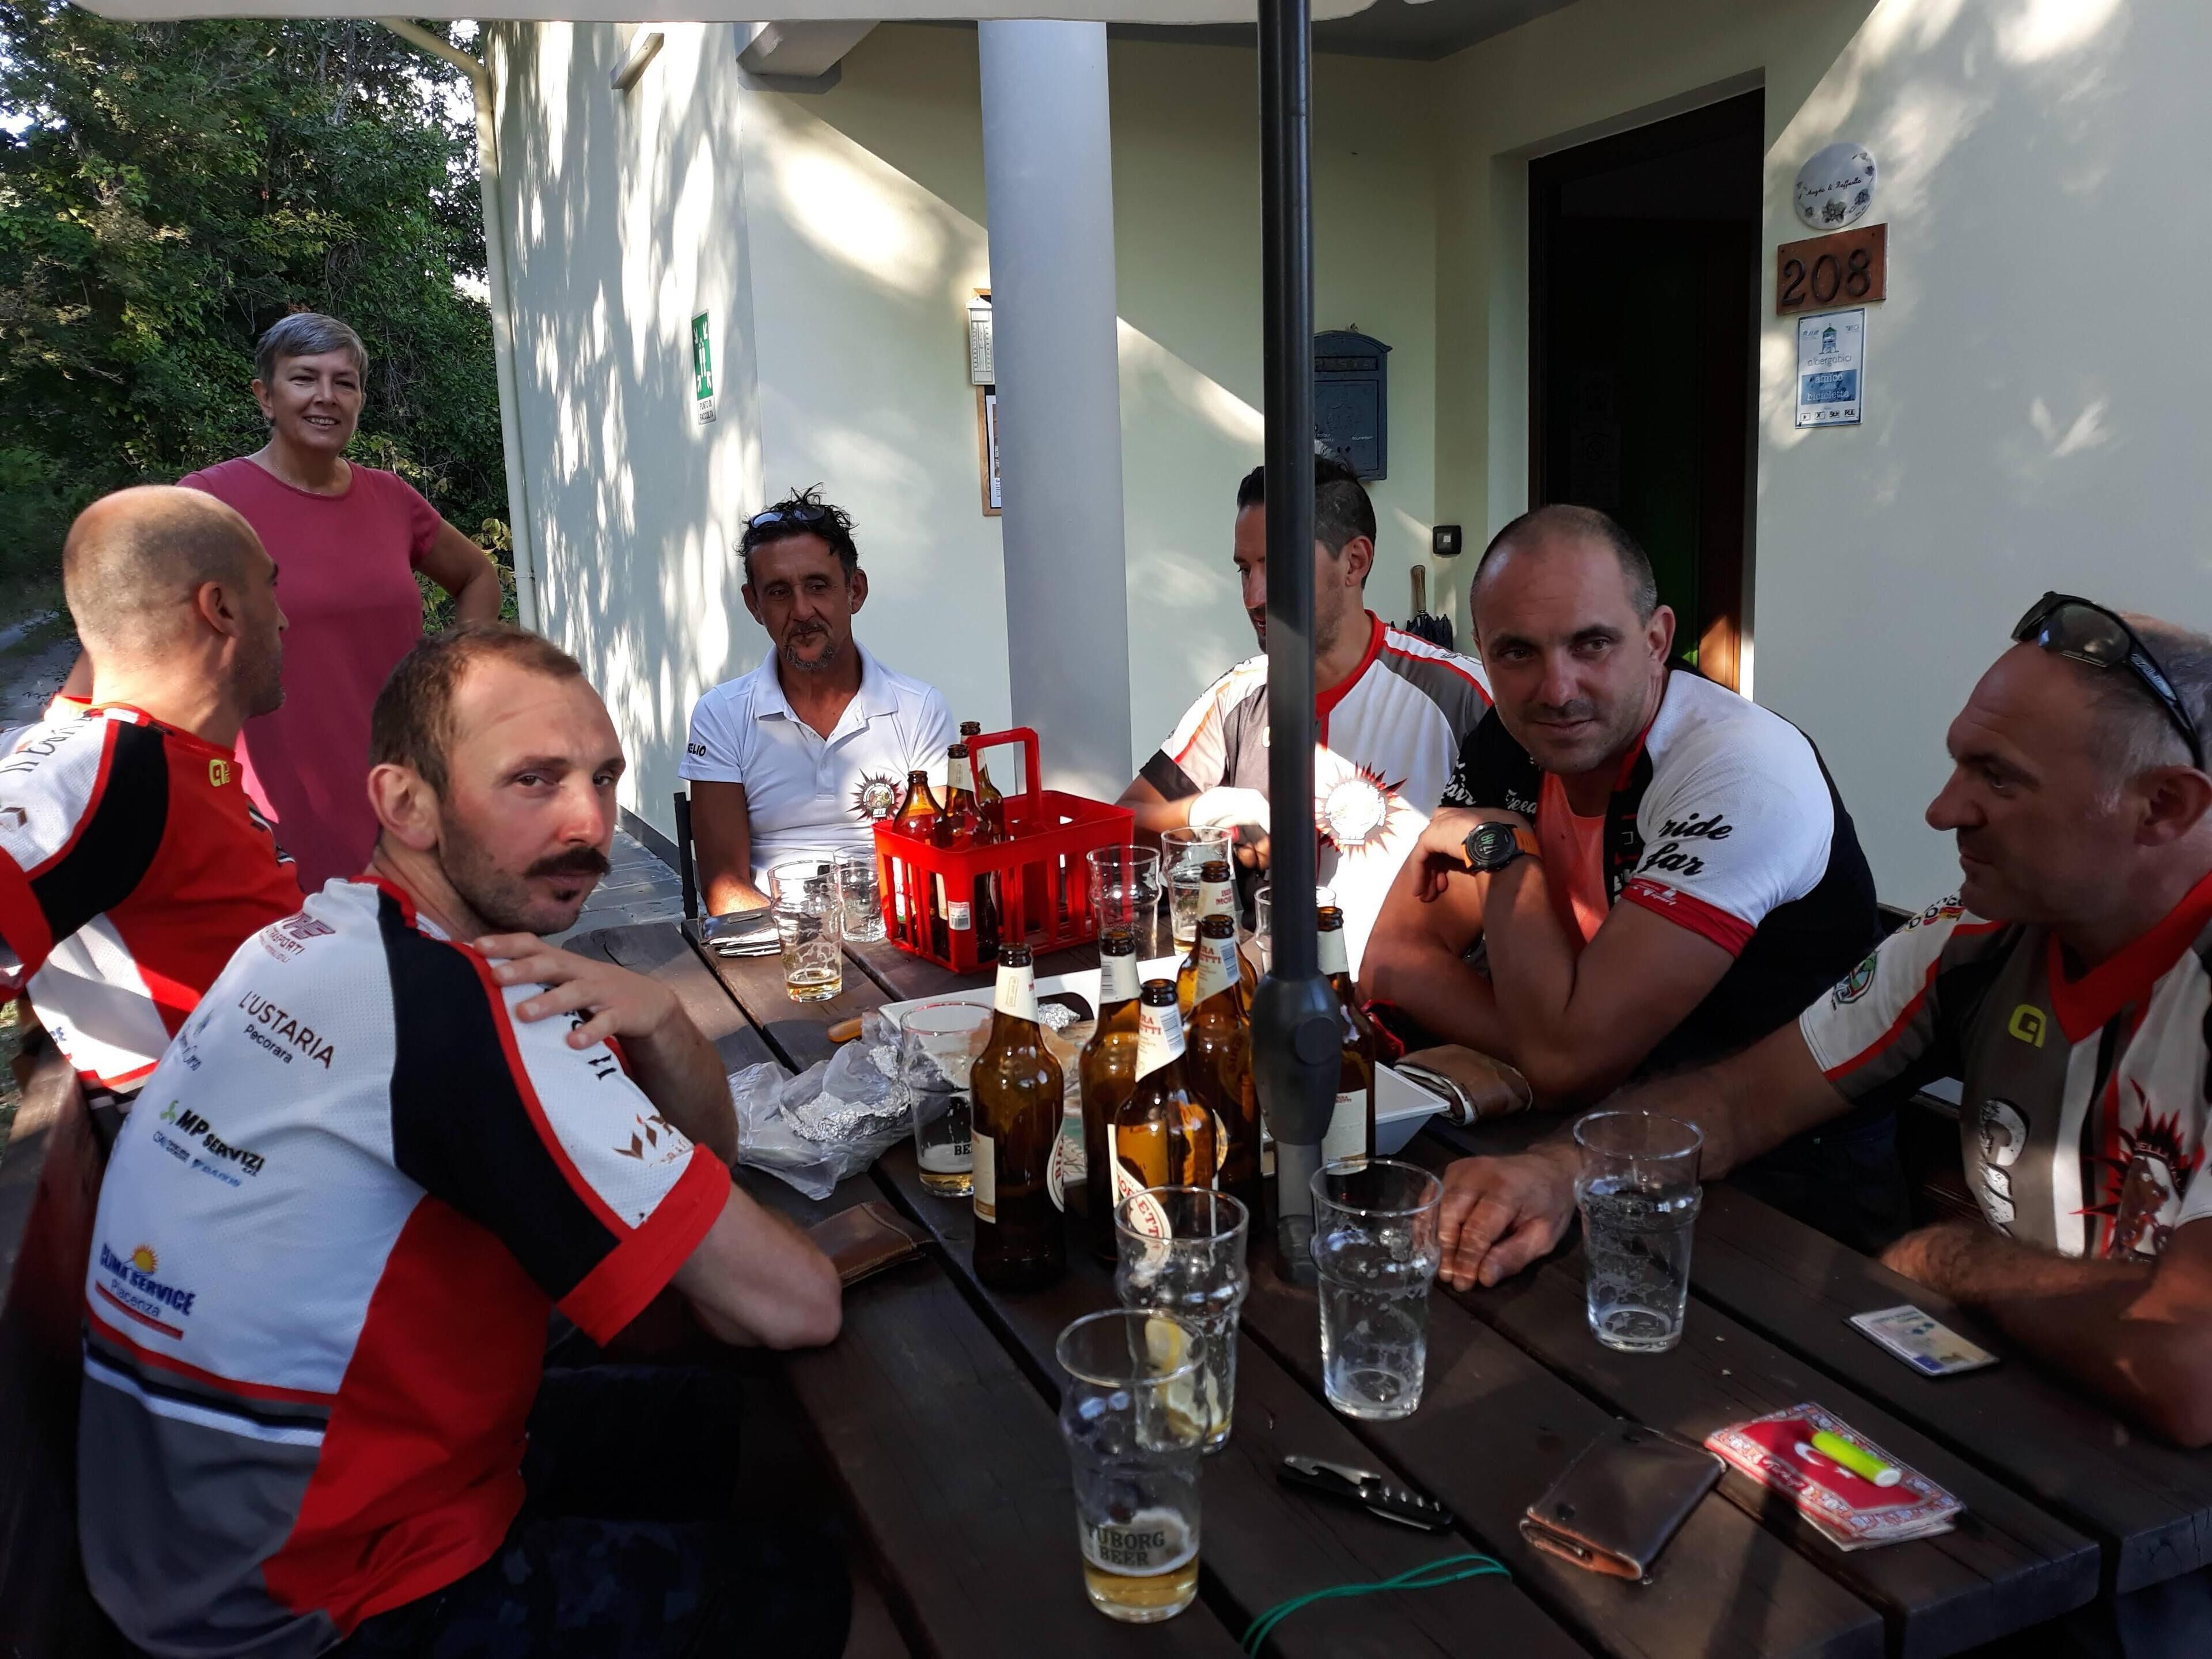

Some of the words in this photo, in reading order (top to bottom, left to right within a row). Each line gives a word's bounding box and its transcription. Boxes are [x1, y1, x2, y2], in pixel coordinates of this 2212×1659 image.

[1782, 248, 1871, 306] 208
[1807, 390, 1849, 401] bicicletta
[1815, 374, 1843, 383] amico
[1658, 813, 1733, 840] ride
[1637, 843, 1705, 876] far
[238, 990, 334, 1069] L'USTARIA
[243, 1024, 293, 1064] Pecorara
[175, 1109, 210, 1137] MP
[202, 1133, 265, 1172] SERVIZI
[110, 1278, 161, 1317] Piacenza
[130, 1271, 196, 1317] SERVICE
[1100, 1546, 1150, 1566] BEER
